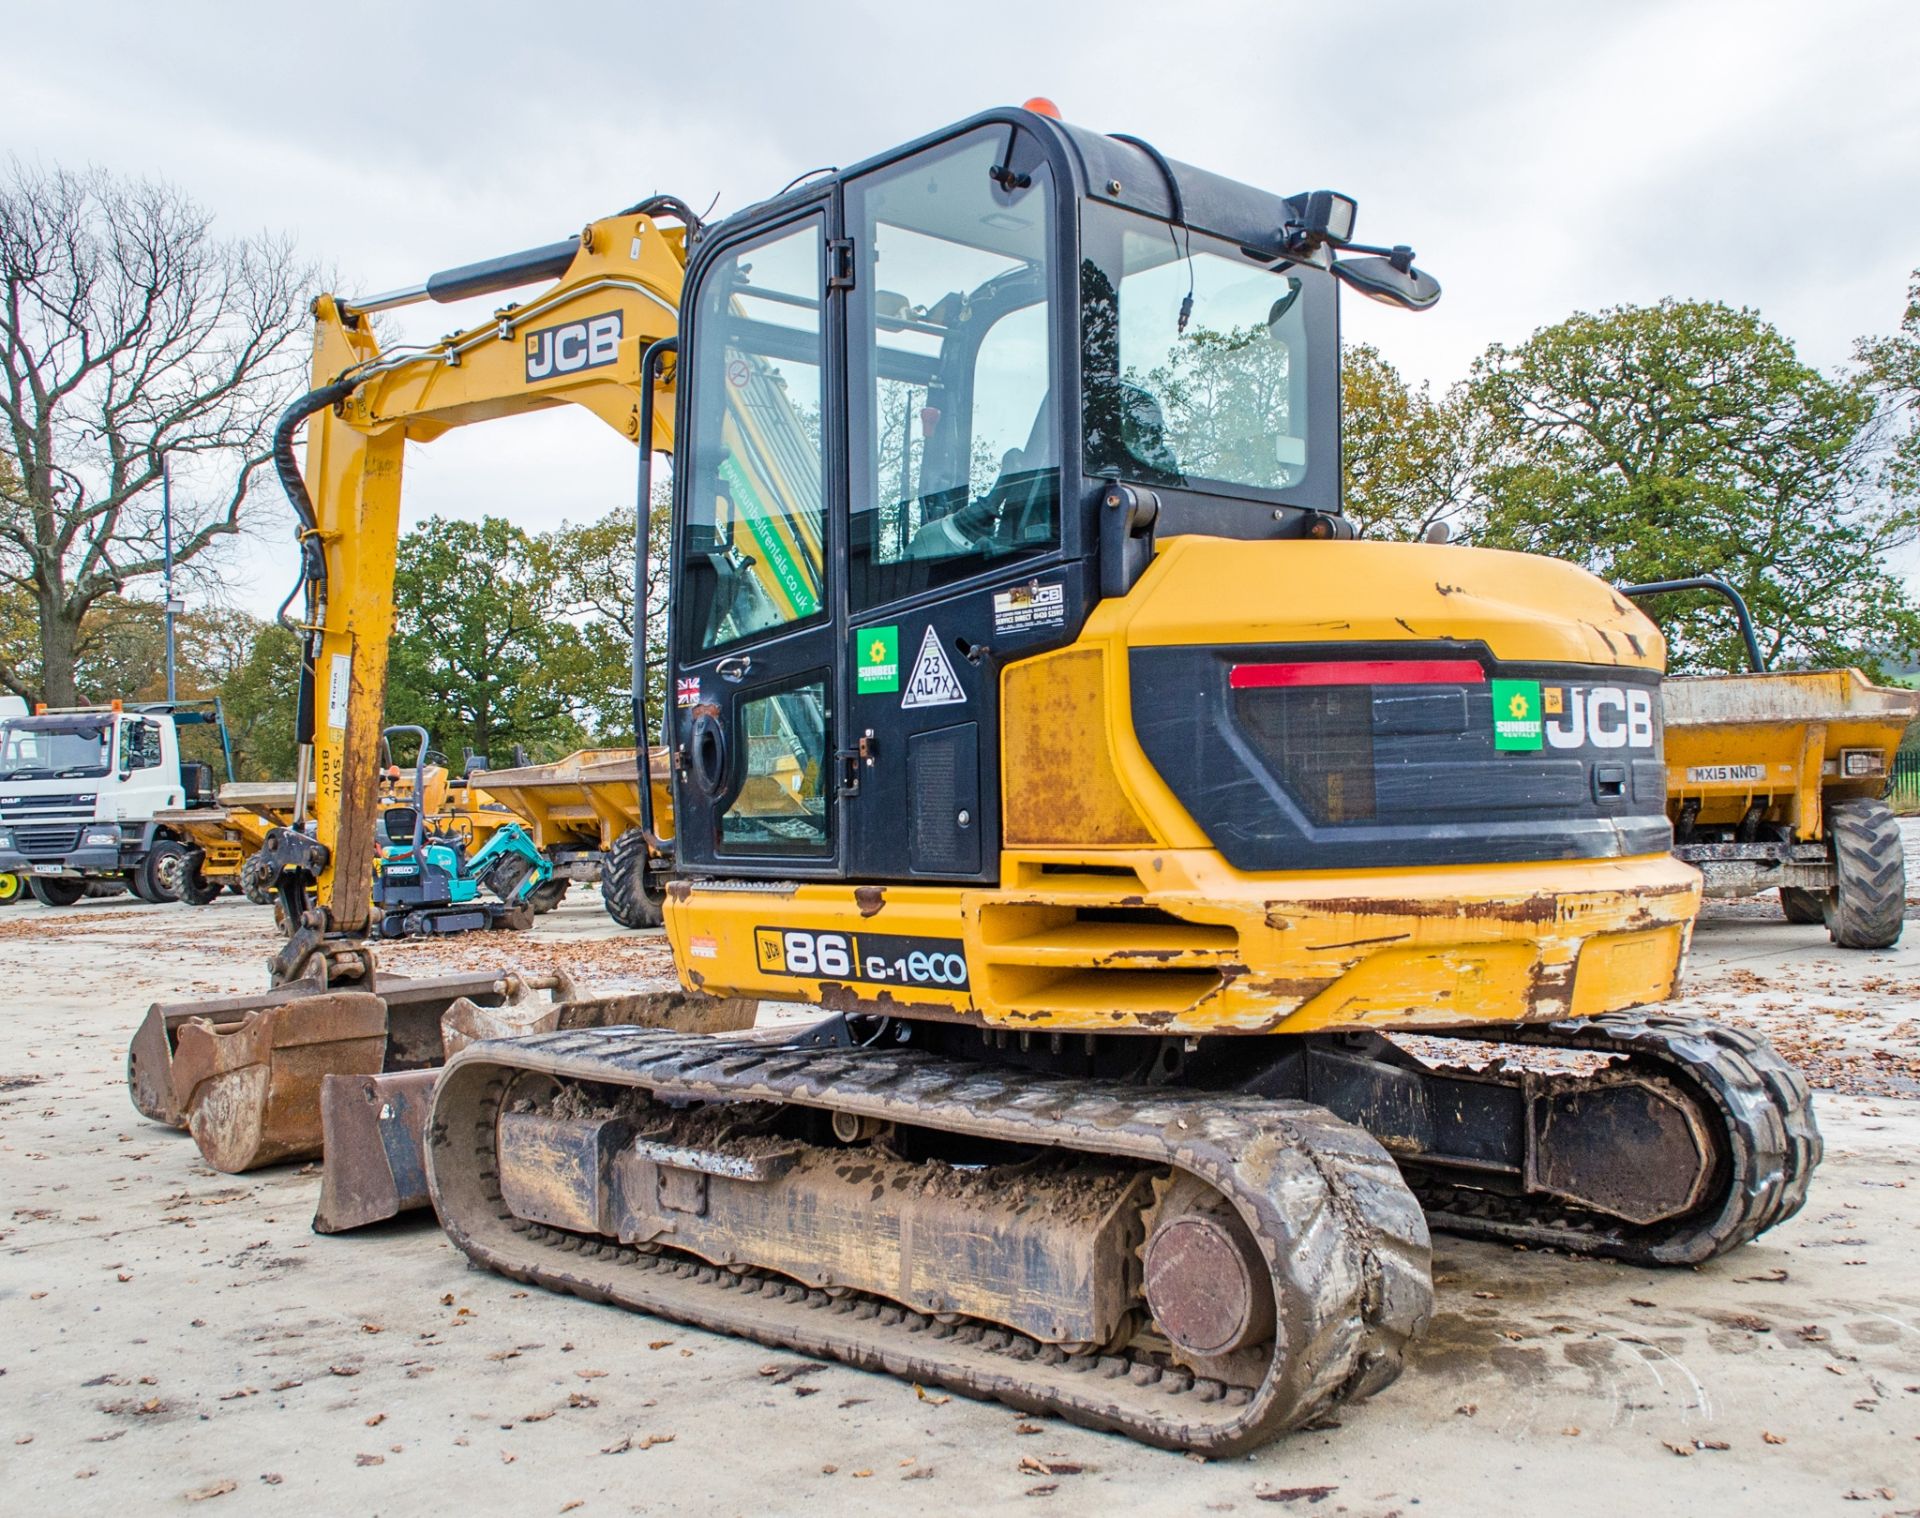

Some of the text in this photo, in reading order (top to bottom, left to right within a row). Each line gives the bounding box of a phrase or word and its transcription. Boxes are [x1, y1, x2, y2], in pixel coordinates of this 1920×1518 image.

[528, 315, 620, 378] JCB
[1031, 590, 1060, 604] JCB
[859, 664, 897, 677] SUNBELT
[924, 656, 940, 675] 23
[863, 674, 892, 682] RENTALS
[917, 675, 950, 696] AL7X
[1496, 720, 1541, 733] SUNBELT
[1545, 687, 1653, 748] JCB
[333, 759, 341, 798] SWL
[1695, 768, 1726, 780] MX15
[785, 932, 850, 976] 86
